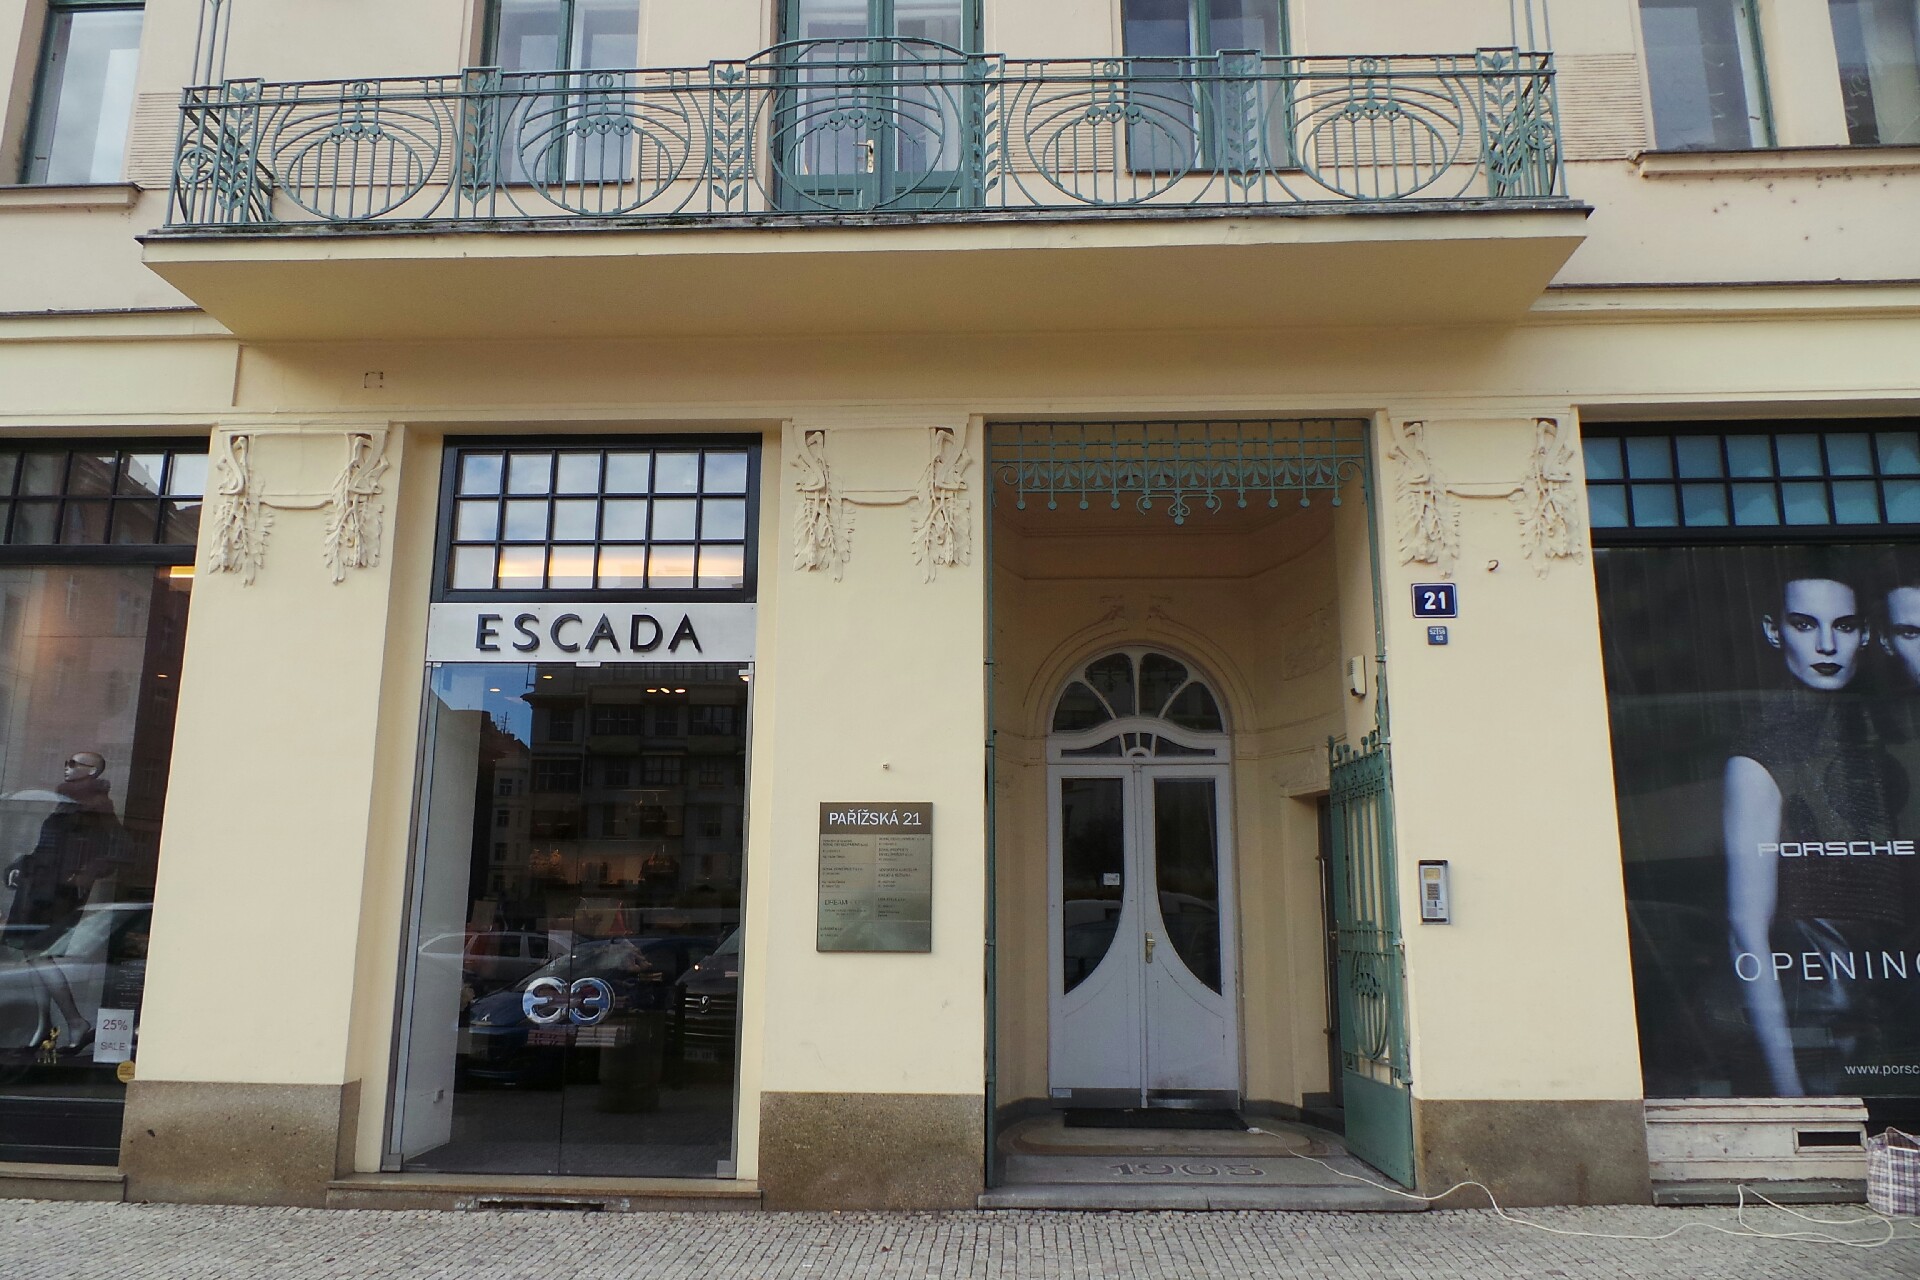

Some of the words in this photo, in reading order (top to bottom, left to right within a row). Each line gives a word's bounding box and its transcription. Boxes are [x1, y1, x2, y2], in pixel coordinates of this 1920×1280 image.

[1424, 591, 1446, 610] 21
[475, 612, 703, 654] ESCADA
[829, 809, 899, 826] PAŘÍŽSKÁ
[902, 812, 922, 826] 21
[1757, 840, 1916, 858] PORSCHE
[1734, 950, 1920, 983] OPENIN
[102, 1019, 128, 1031] 25%
[100, 1042, 126, 1051] SALE
[1108, 1162, 1266, 1177] 1905
